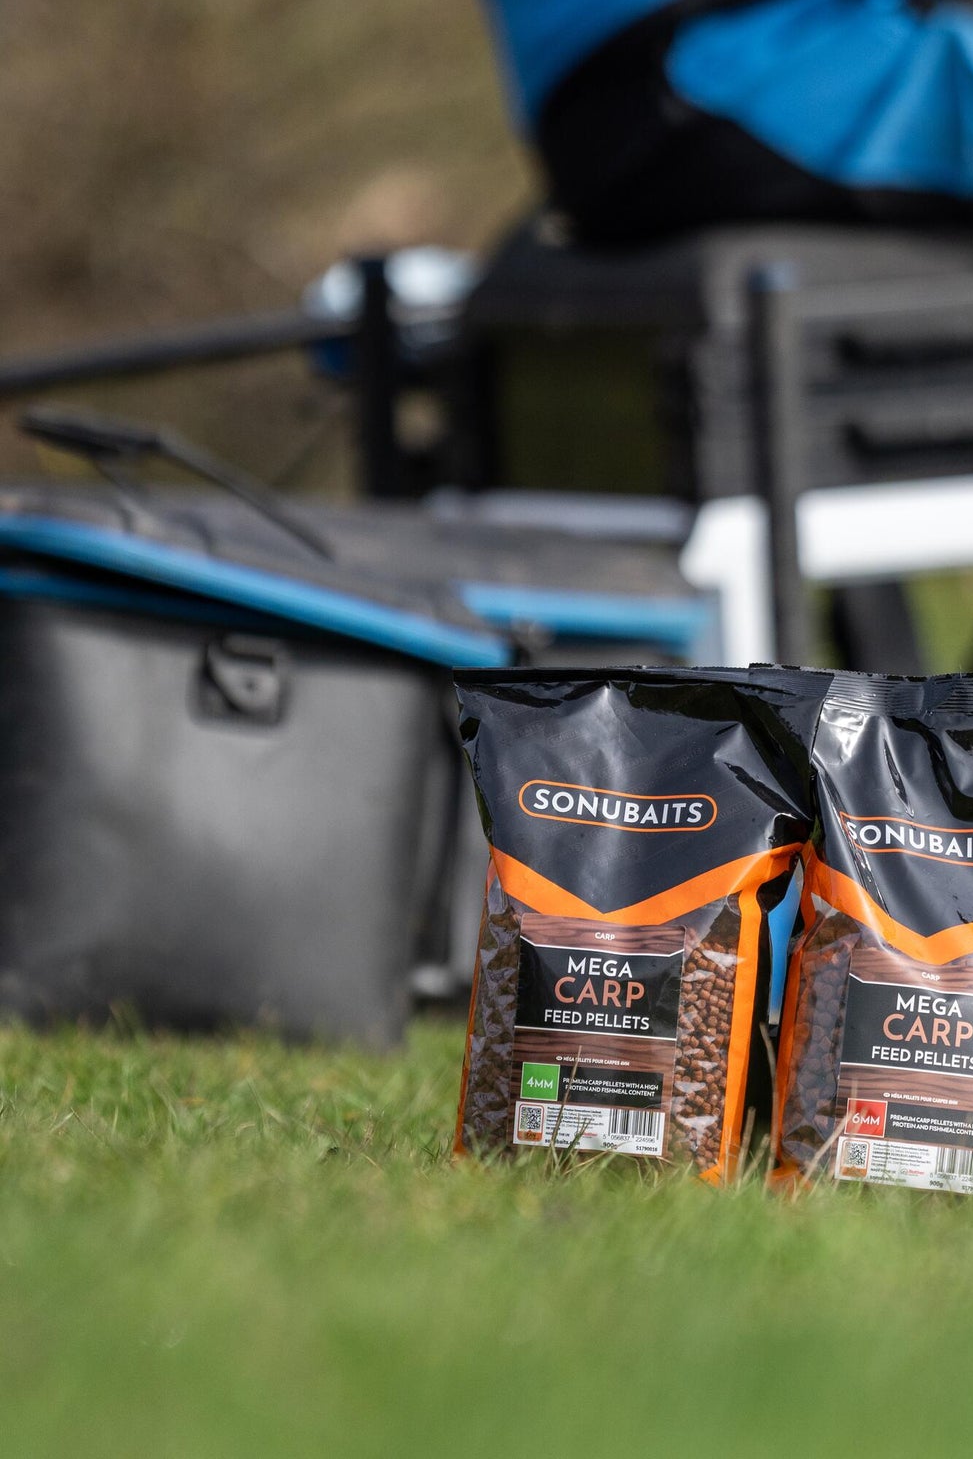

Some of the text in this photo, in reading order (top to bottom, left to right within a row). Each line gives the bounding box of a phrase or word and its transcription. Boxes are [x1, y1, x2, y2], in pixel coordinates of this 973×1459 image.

[533, 789, 703, 824] SONUBAITS
[595, 932, 615, 940] CARP
[568, 955, 632, 978] MEGA
[922, 971, 941, 981] CARP
[554, 976, 645, 1008] CARP
[896, 992, 962, 1018] MEGA
[545, 1009, 649, 1030] FEED PELLETS
[883, 1013, 973, 1048] CARP
[872, 1046, 911, 1062] FEED
[527, 1076, 554, 1089] 4MM
[629, 1089, 655, 1097] CONTENT
[852, 1112, 880, 1125] 6MM
[890, 1114, 915, 1122] PREMIUM
[931, 1118, 953, 1126] PELLETS
[929, 1125, 955, 1133] FISHMEAL
[930, 1180, 943, 1188] 900g
